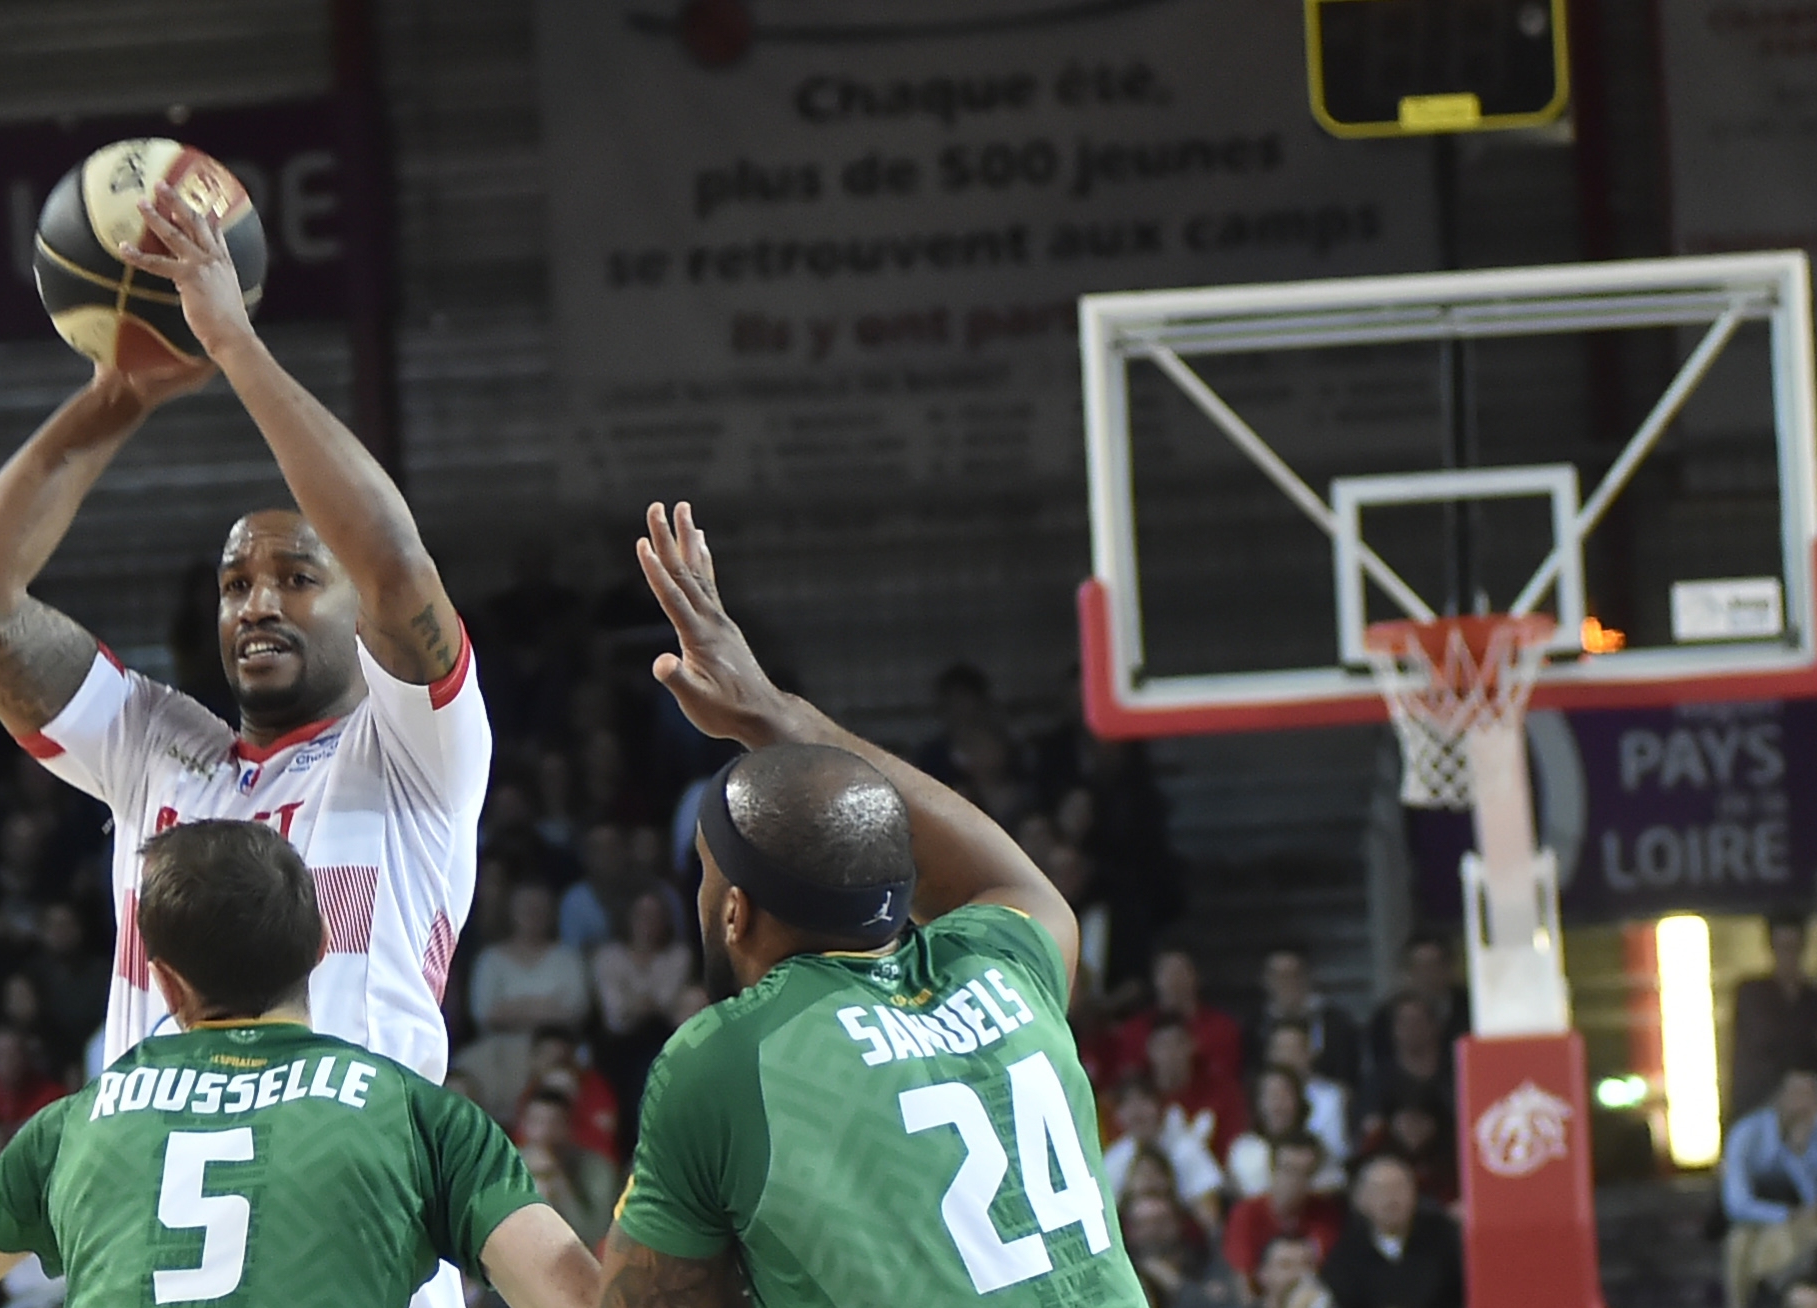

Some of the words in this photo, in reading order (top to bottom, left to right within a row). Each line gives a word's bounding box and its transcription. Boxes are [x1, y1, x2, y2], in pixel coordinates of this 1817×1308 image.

[796, 65, 1033, 128] Chaque
[694, 156, 820, 218] plus
[843, 144, 917, 197] de
[939, 137, 1054, 188] 500
[1073, 132, 1286, 196] jeunes
[606, 243, 669, 287] se
[688, 224, 1029, 279] retrouvent
[1049, 217, 1159, 264] aux
[1185, 198, 1382, 259] camps
[1619, 723, 1786, 791] PAYS
[1601, 823, 1790, 890] LOIRE
[837, 968, 1034, 1066] SAMUELS
[88, 1056, 377, 1122] ROUSSELLE
[899, 1051, 1111, 1294] 24
[153, 1127, 254, 1305] 5
